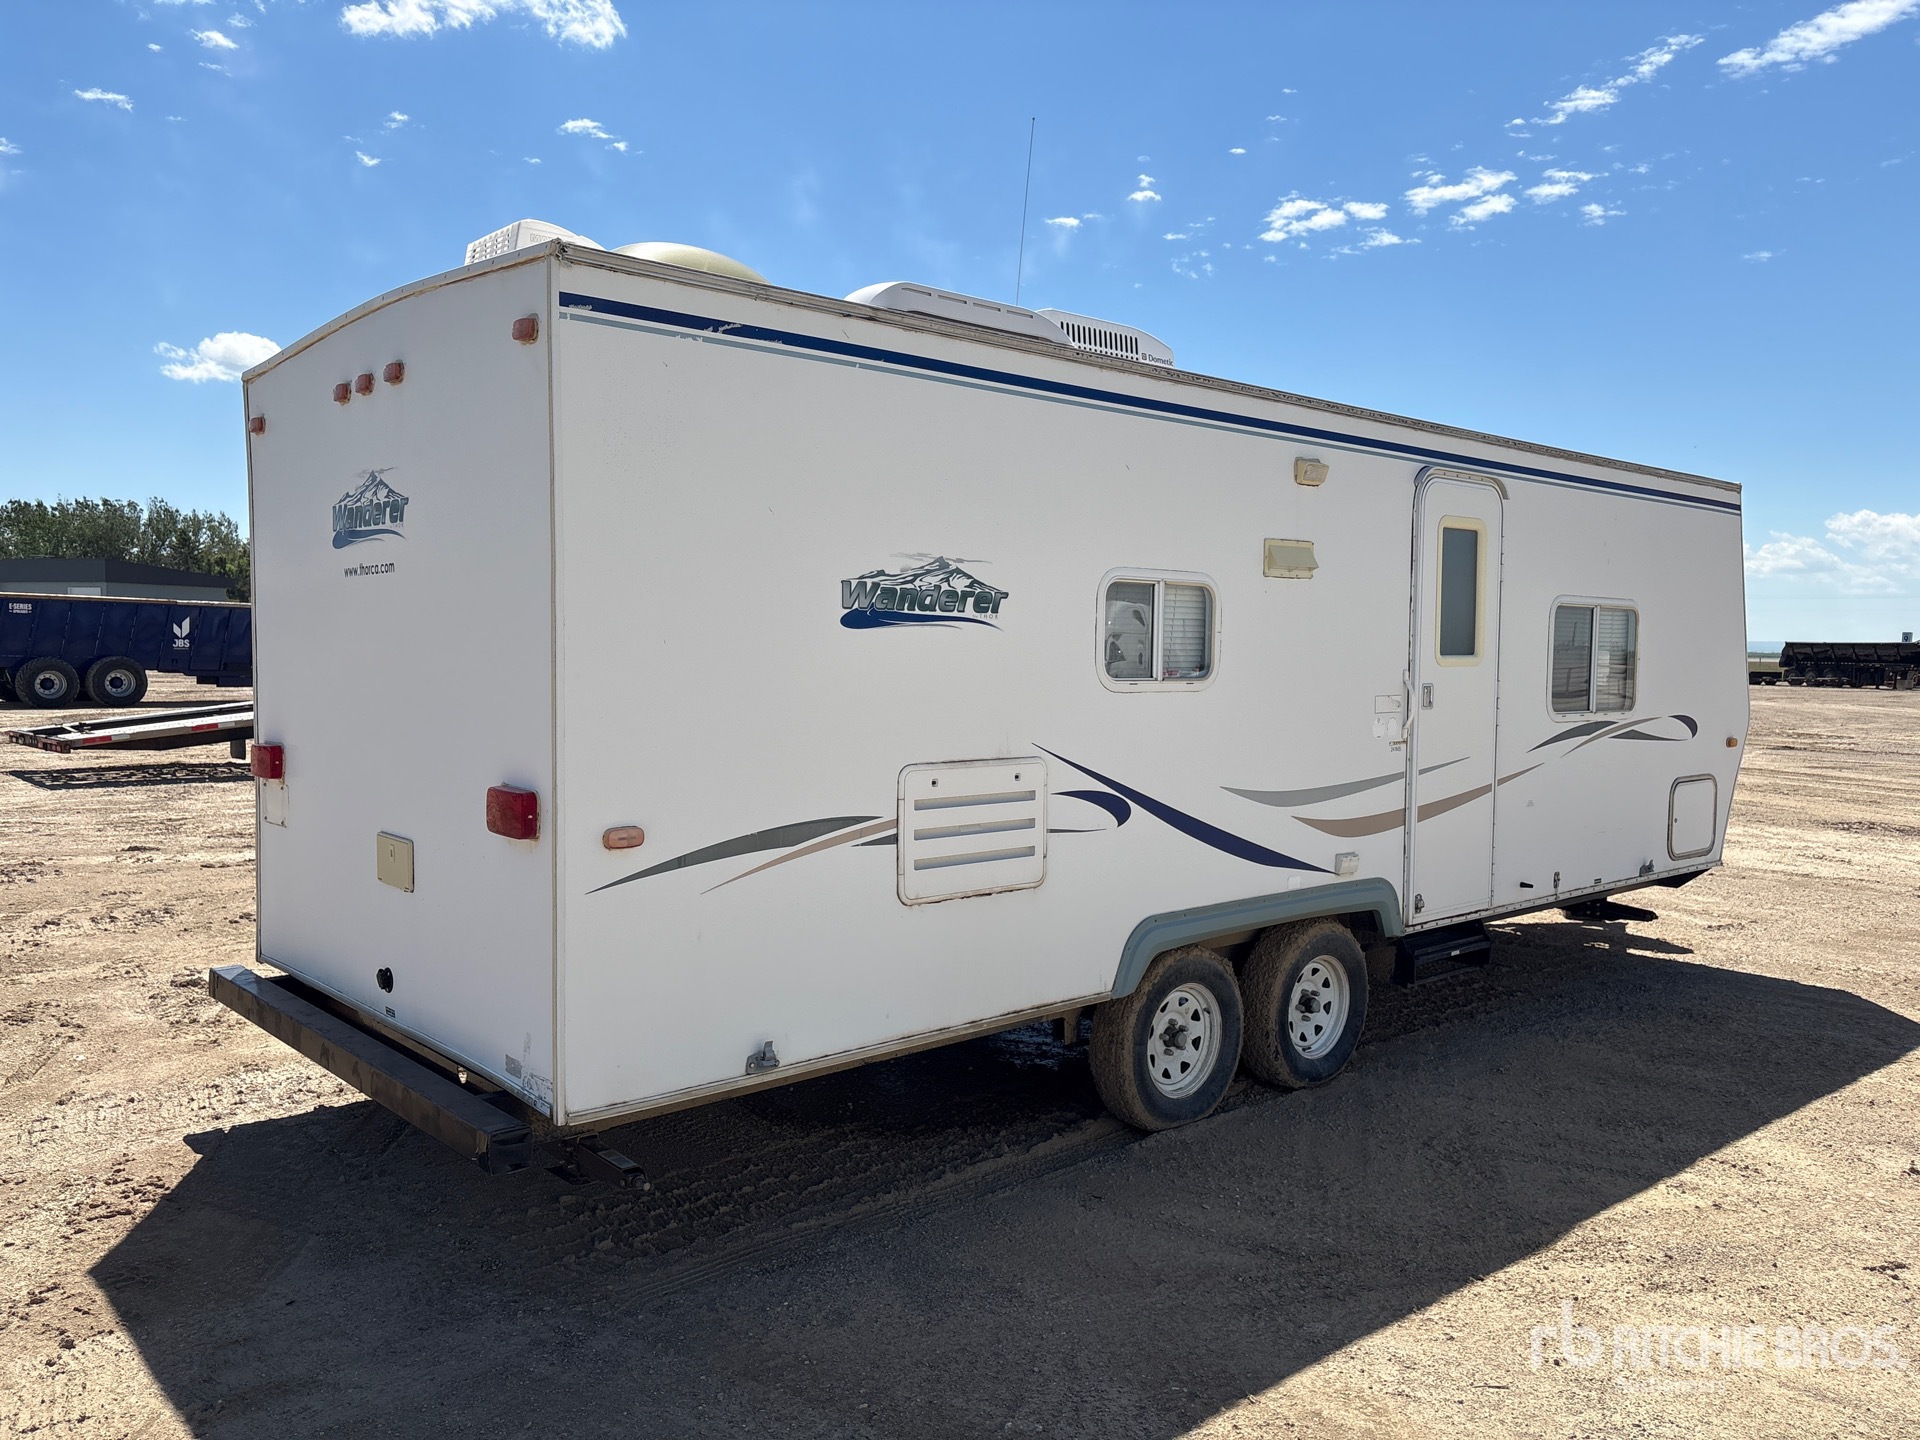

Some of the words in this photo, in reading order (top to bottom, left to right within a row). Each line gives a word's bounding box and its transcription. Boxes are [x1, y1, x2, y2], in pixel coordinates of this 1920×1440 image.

[1149, 354, 1174, 366] Dometic
[332, 497, 409, 532] Wanderer
[344, 562, 396, 578] www.thorca.com
[841, 580, 1009, 613] Wanderer
[173, 638, 190, 648] JBS
